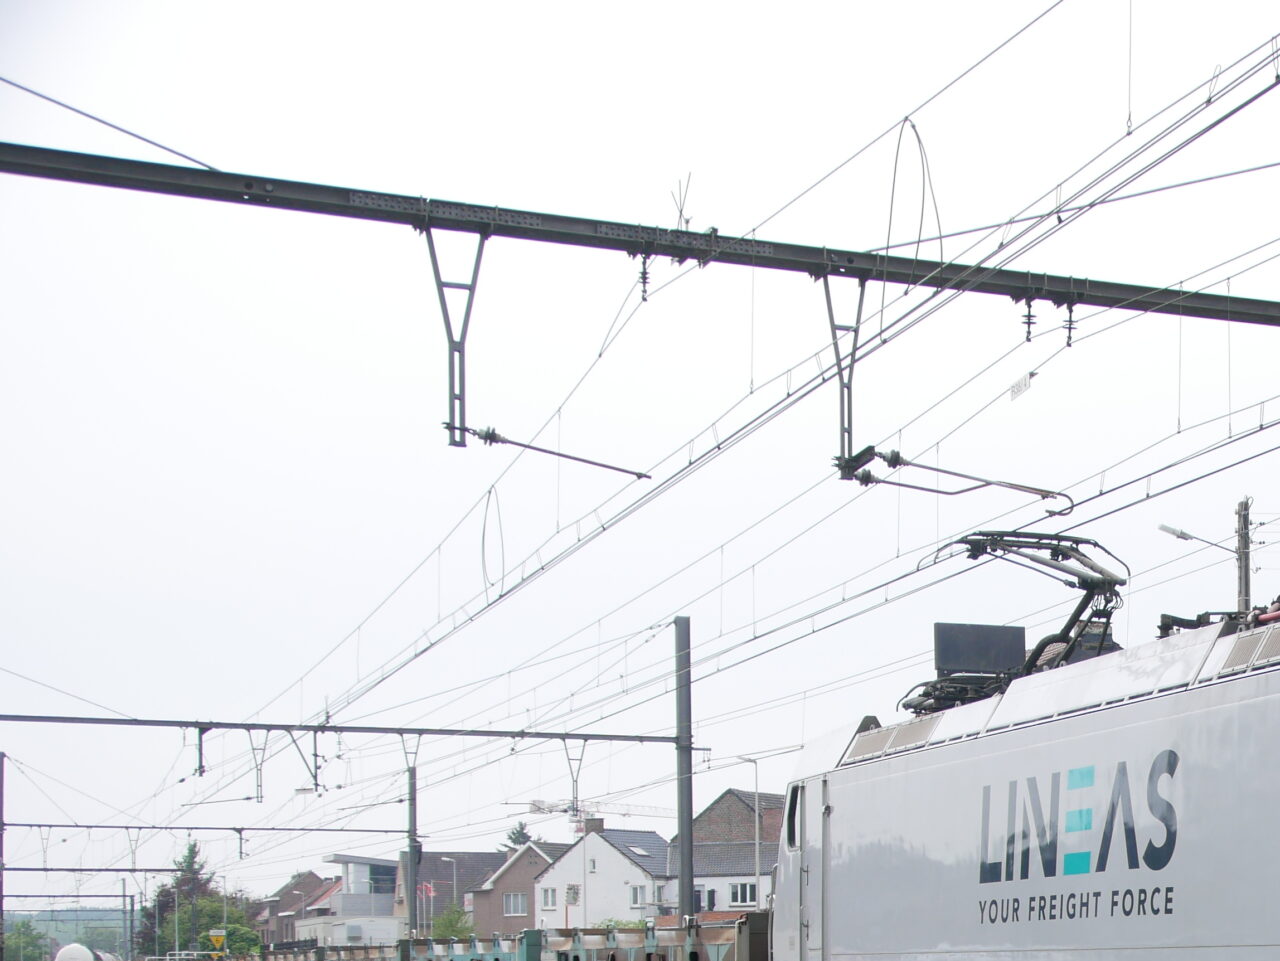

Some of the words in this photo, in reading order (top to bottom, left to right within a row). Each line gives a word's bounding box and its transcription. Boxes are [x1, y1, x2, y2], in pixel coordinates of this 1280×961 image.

[979, 749, 1180, 884] LINEAS
[979, 898, 1020, 924] YOUR
[1028, 891, 1102, 921] FREIGHT
[1110, 886, 1174, 917] FORCE
